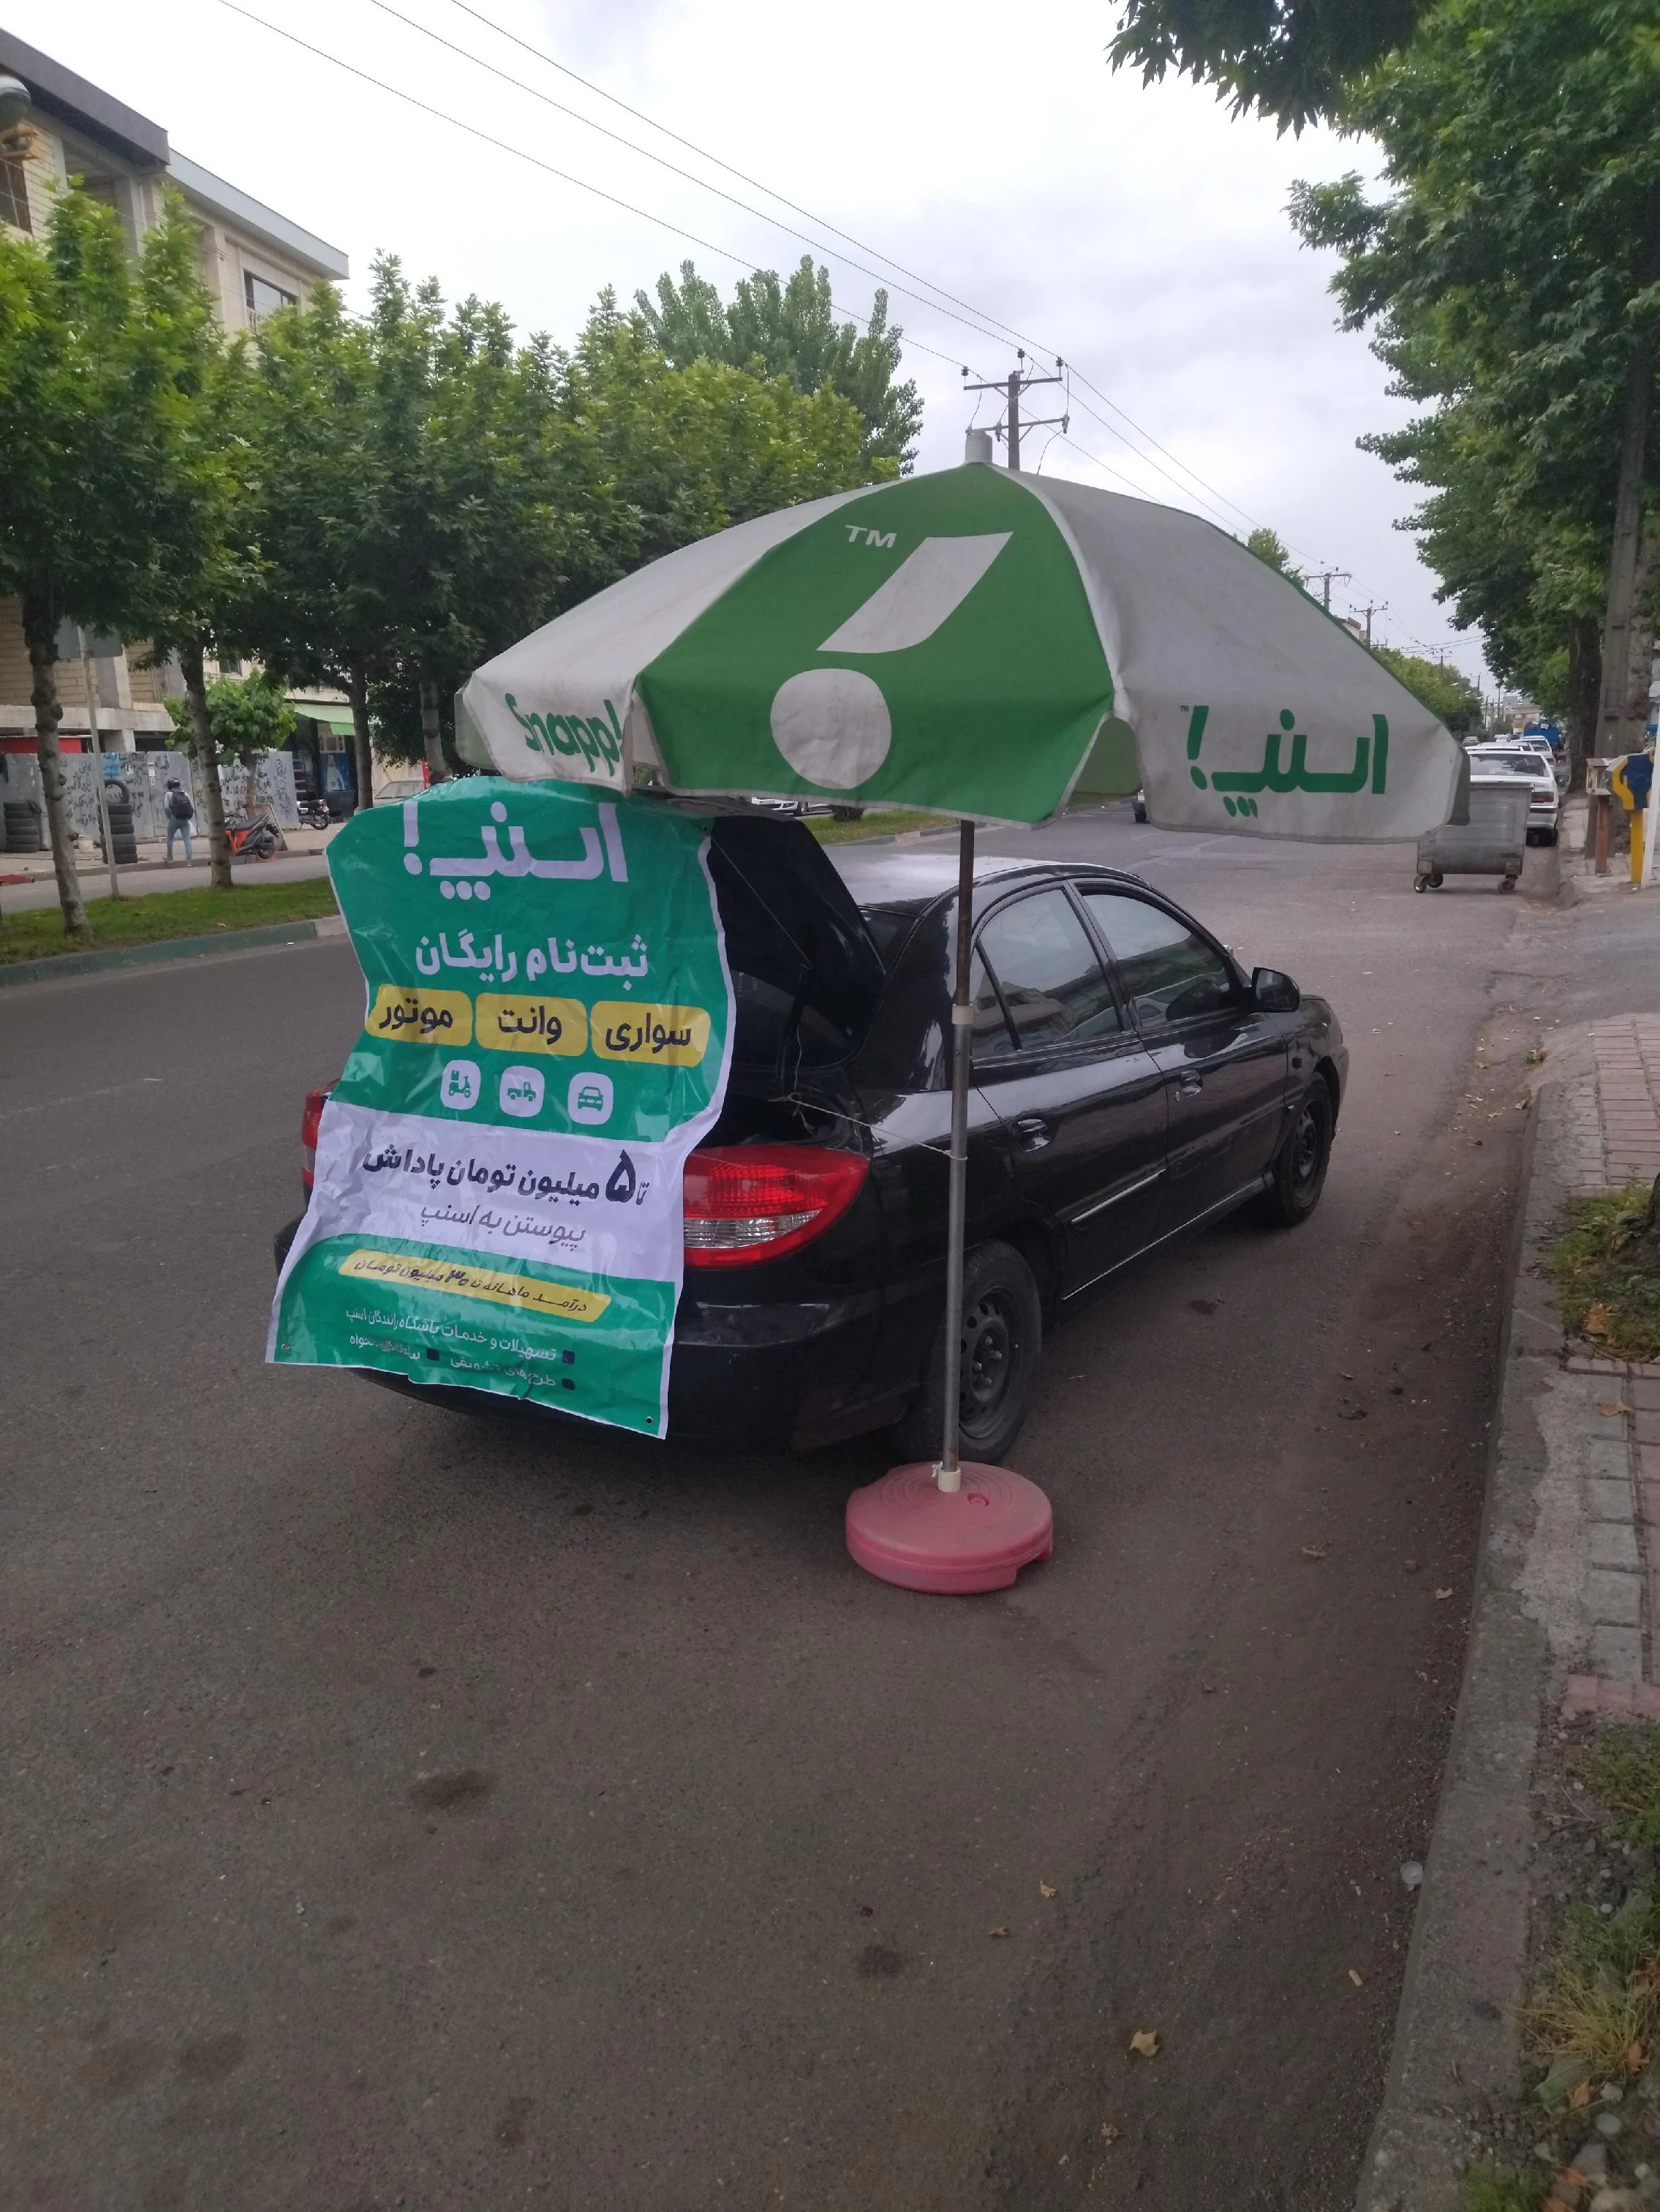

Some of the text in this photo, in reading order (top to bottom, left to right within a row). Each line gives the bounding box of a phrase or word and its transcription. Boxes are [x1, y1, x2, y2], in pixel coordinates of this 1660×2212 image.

[845, 525, 896, 548] TM
[415, 928, 517, 982] رایگان
[379, 997, 453, 1034] موتور
[497, 1006, 562, 1045] وانت
[605, 1013, 692, 1053] سواری
[363, 1144, 445, 1190] پاداش
[447, 1159, 517, 1193] تومان
[517, 1170, 600, 1206] میلیون
[421, 1204, 586, 1251] پیوستن به اسنپ
[354, 1260, 401, 1275] تومان
[399, 1267, 444, 1283] میلیون
[469, 1278, 482, 1288] تا
[346, 1307, 557, 1360] تسهیلات و خدمات باشگاه رانندگان اسنپ
